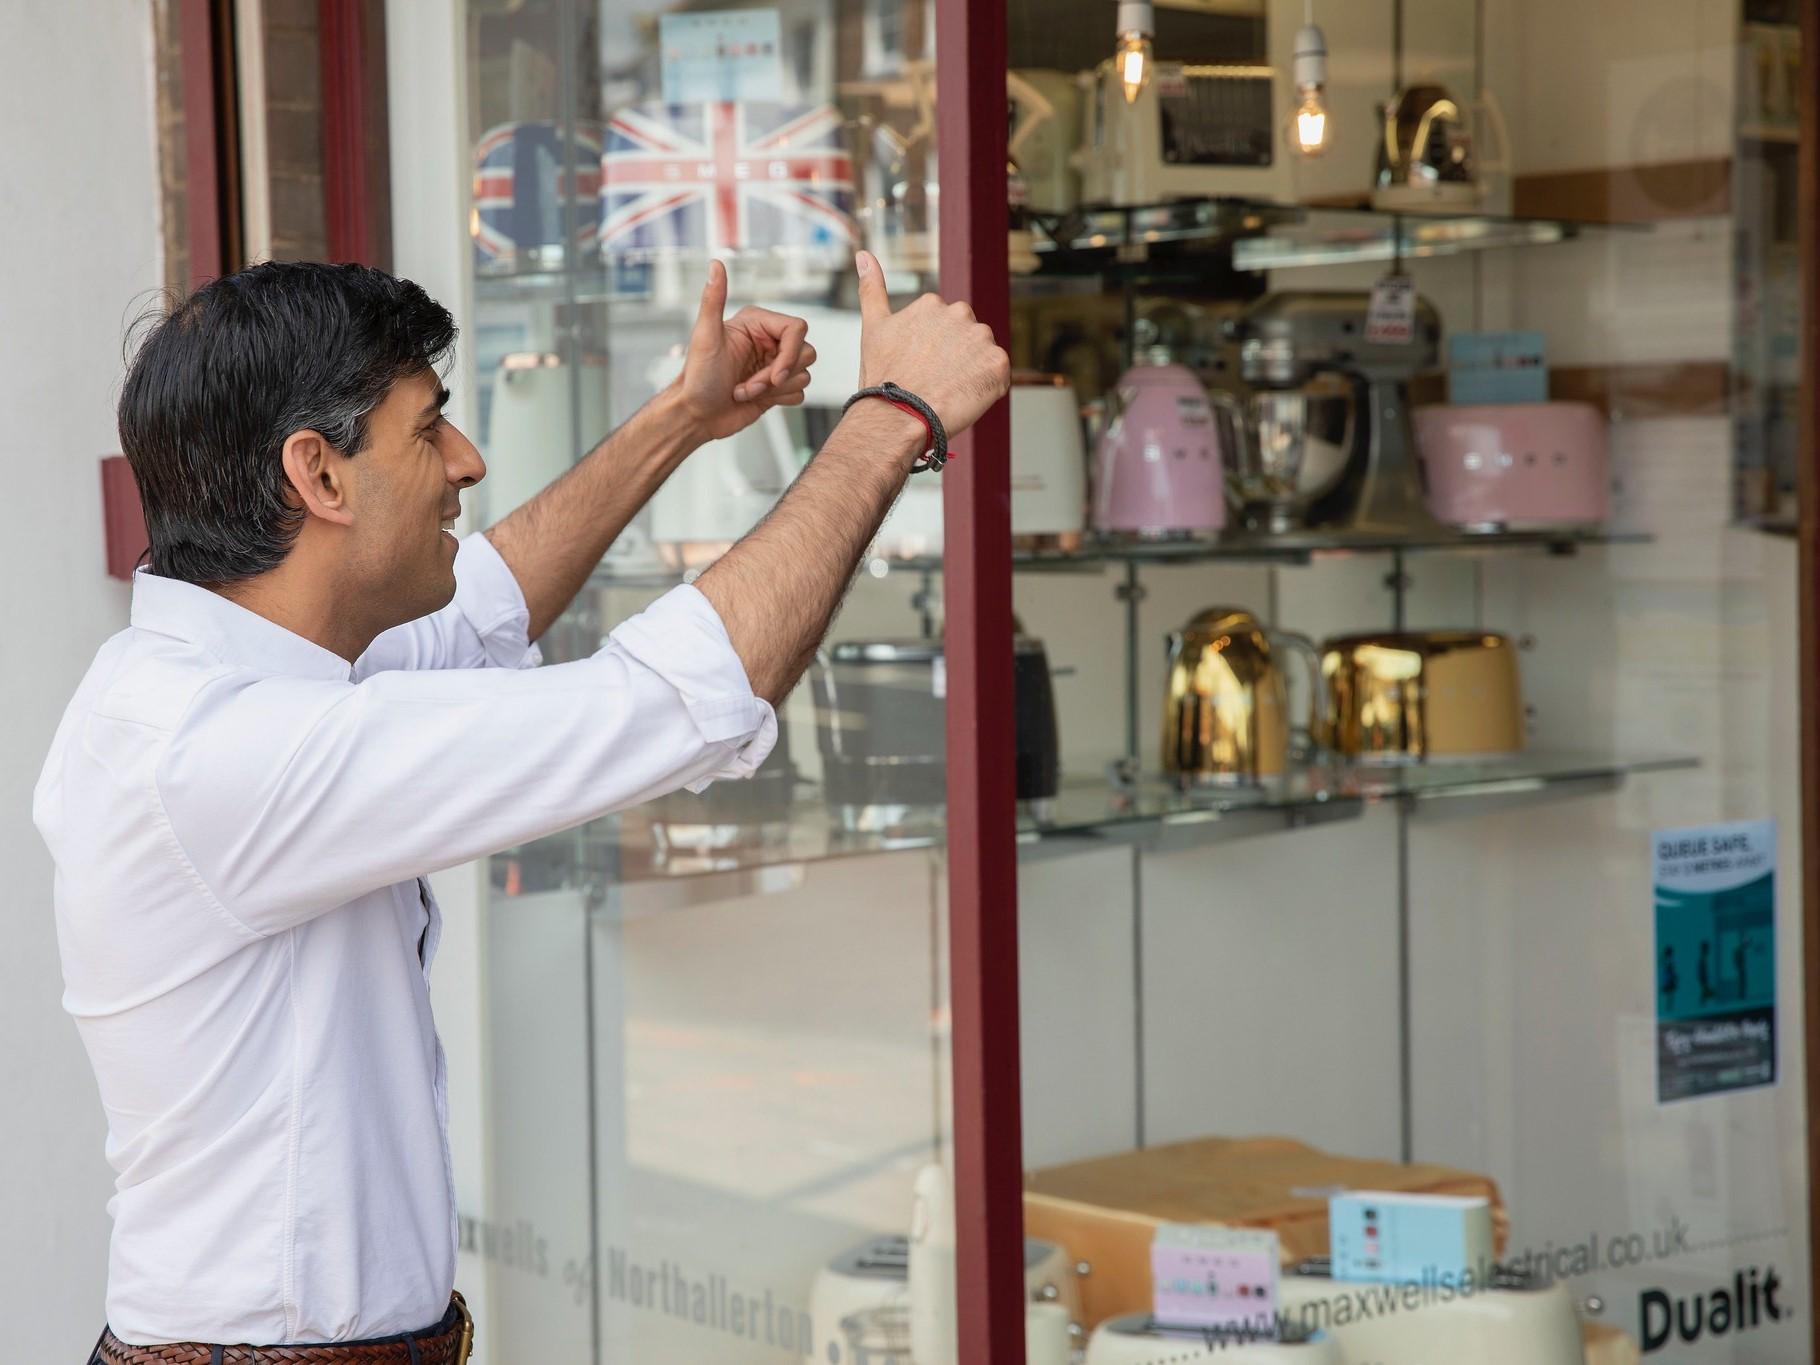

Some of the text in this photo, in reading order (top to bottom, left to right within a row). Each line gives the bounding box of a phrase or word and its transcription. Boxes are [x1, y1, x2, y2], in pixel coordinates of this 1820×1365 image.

[663, 160, 789, 181] SMEG
[1658, 837, 1708, 860] QUEUE
[607, 1246, 815, 1357] Northallerton
